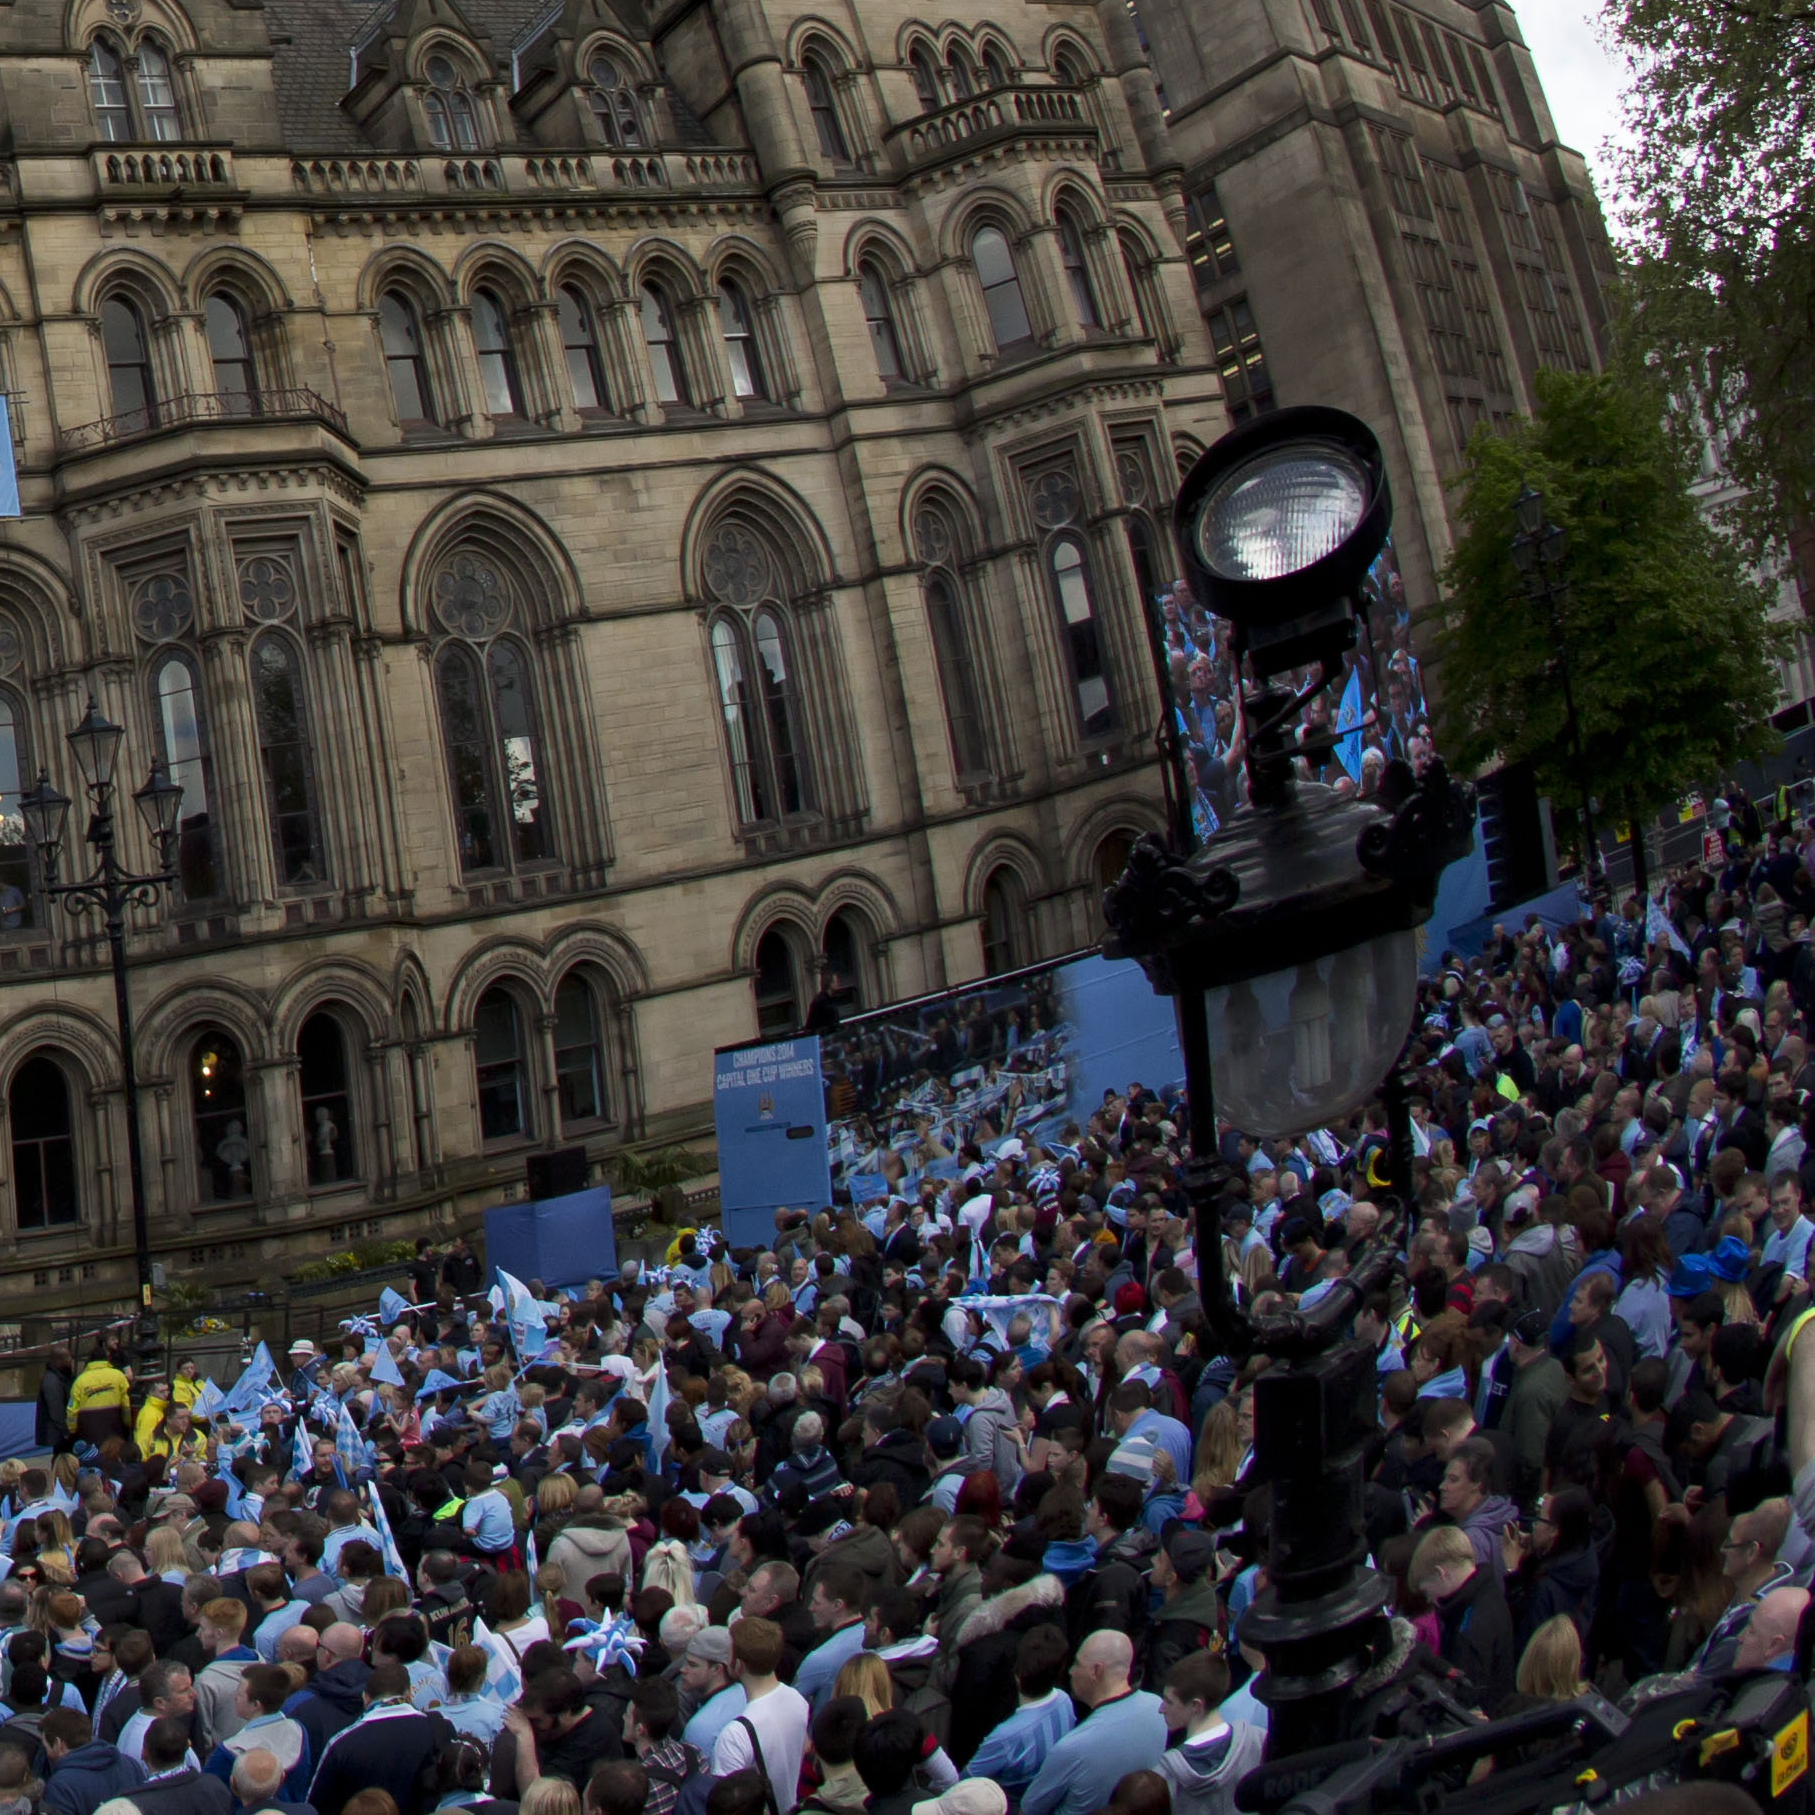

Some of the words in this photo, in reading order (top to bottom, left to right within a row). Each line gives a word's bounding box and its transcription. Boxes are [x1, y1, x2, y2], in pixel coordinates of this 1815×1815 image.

[733, 1045, 776, 1068] CHAMPIONS
[777, 1043, 795, 1061] 2014
[716, 1071, 747, 1089] CAPITAL
[746, 1067, 762, 1085] ONE
[762, 1065, 778, 1082] CUP
[778, 1058, 814, 1080] WINNERS
